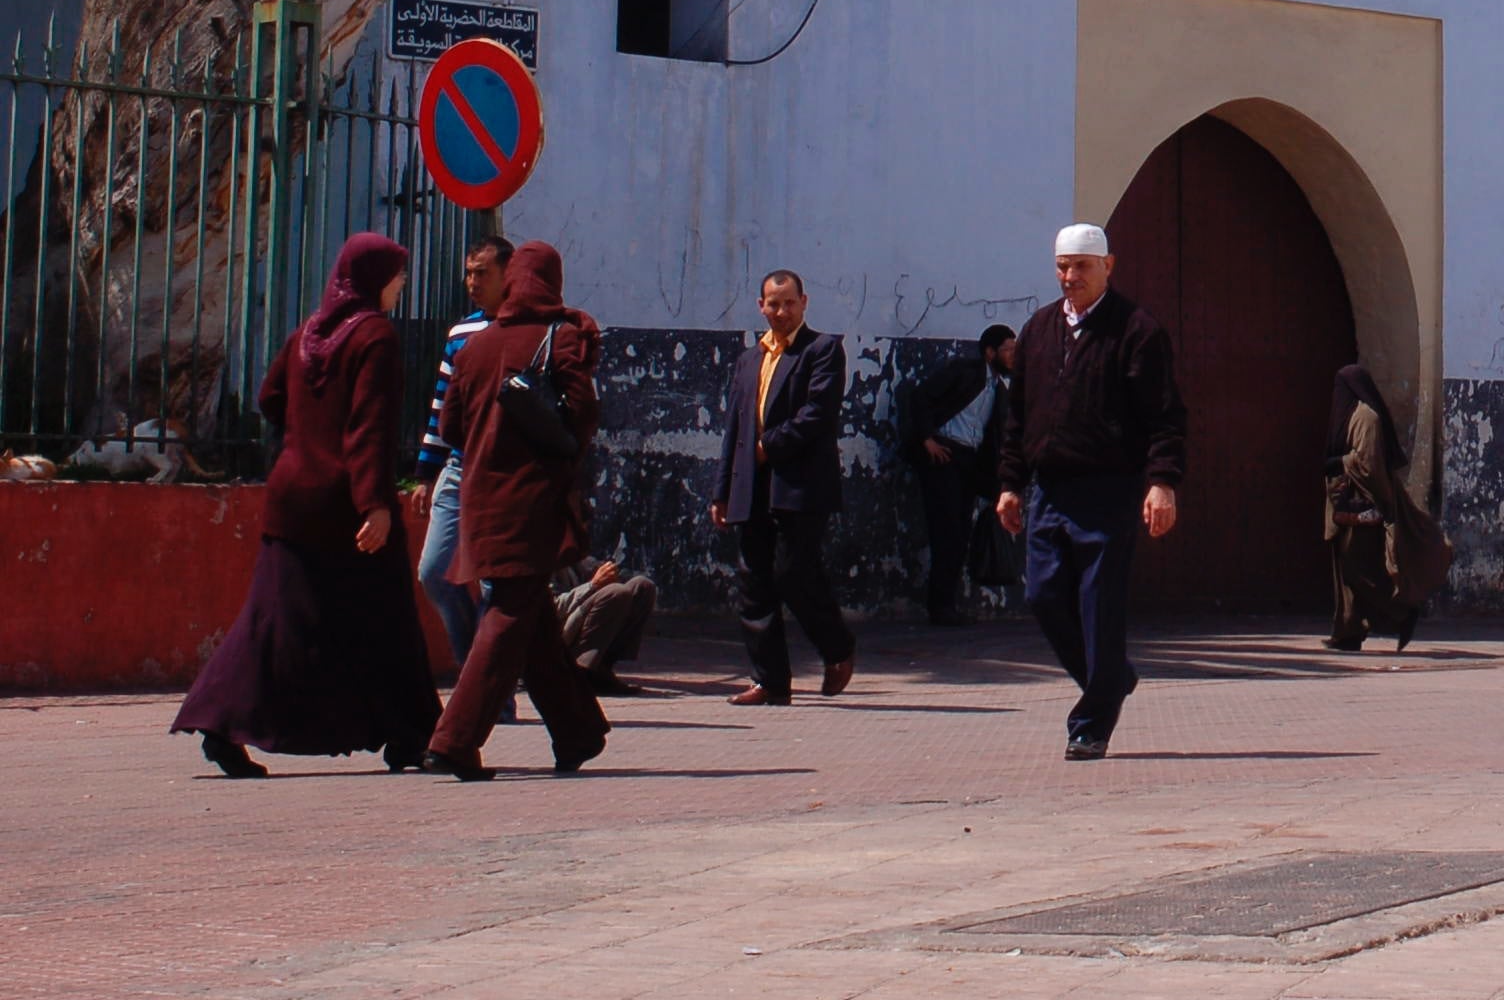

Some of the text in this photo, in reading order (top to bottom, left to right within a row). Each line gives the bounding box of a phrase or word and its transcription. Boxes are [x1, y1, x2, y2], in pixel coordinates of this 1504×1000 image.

[397, 0, 535, 32] المقاطعة الحضرية الأولى
[396, 29, 453, 55] السويقة
[506, 38, 534, 61] مرك
